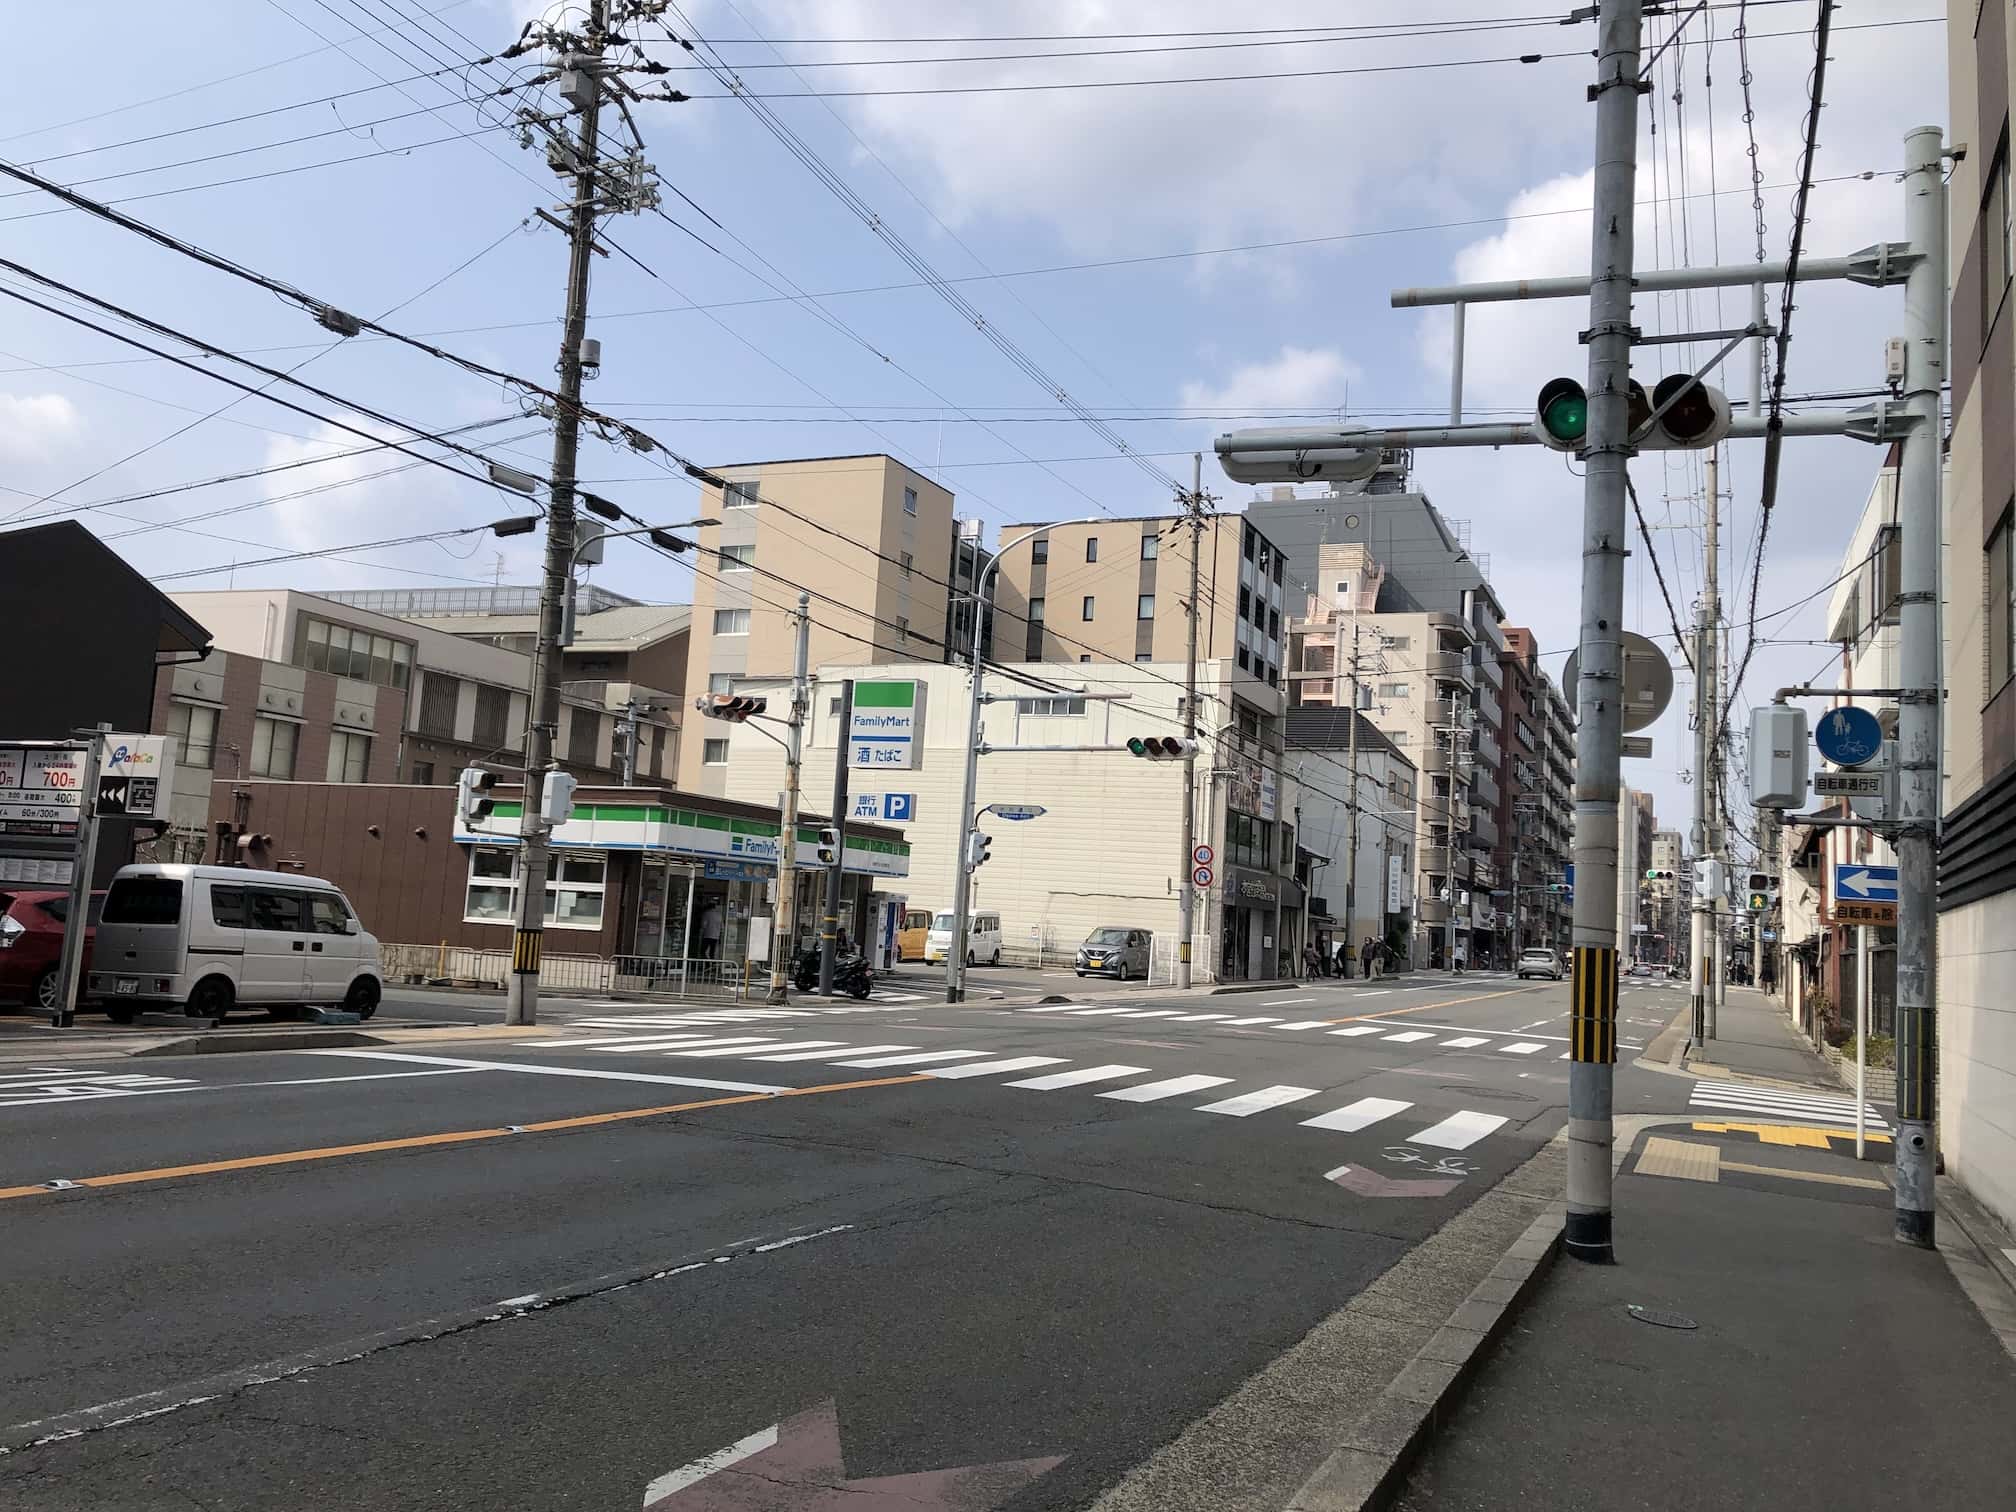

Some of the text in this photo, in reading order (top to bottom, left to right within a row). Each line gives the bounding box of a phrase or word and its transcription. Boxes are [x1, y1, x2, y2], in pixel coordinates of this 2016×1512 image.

[854, 715, 910, 728] FamilyMart
[857, 747, 902, 763] 酒 たばこ
[43, 771, 76, 787] 700円
[1817, 777, 1879, 791] 自転車通行可
[858, 795, 877, 805] 銀行
[890, 796, 905, 817] P
[854, 806, 877, 817] ATM
[1198, 850, 1210, 860] 40
[1837, 906, 1898, 921] 自転車を除
